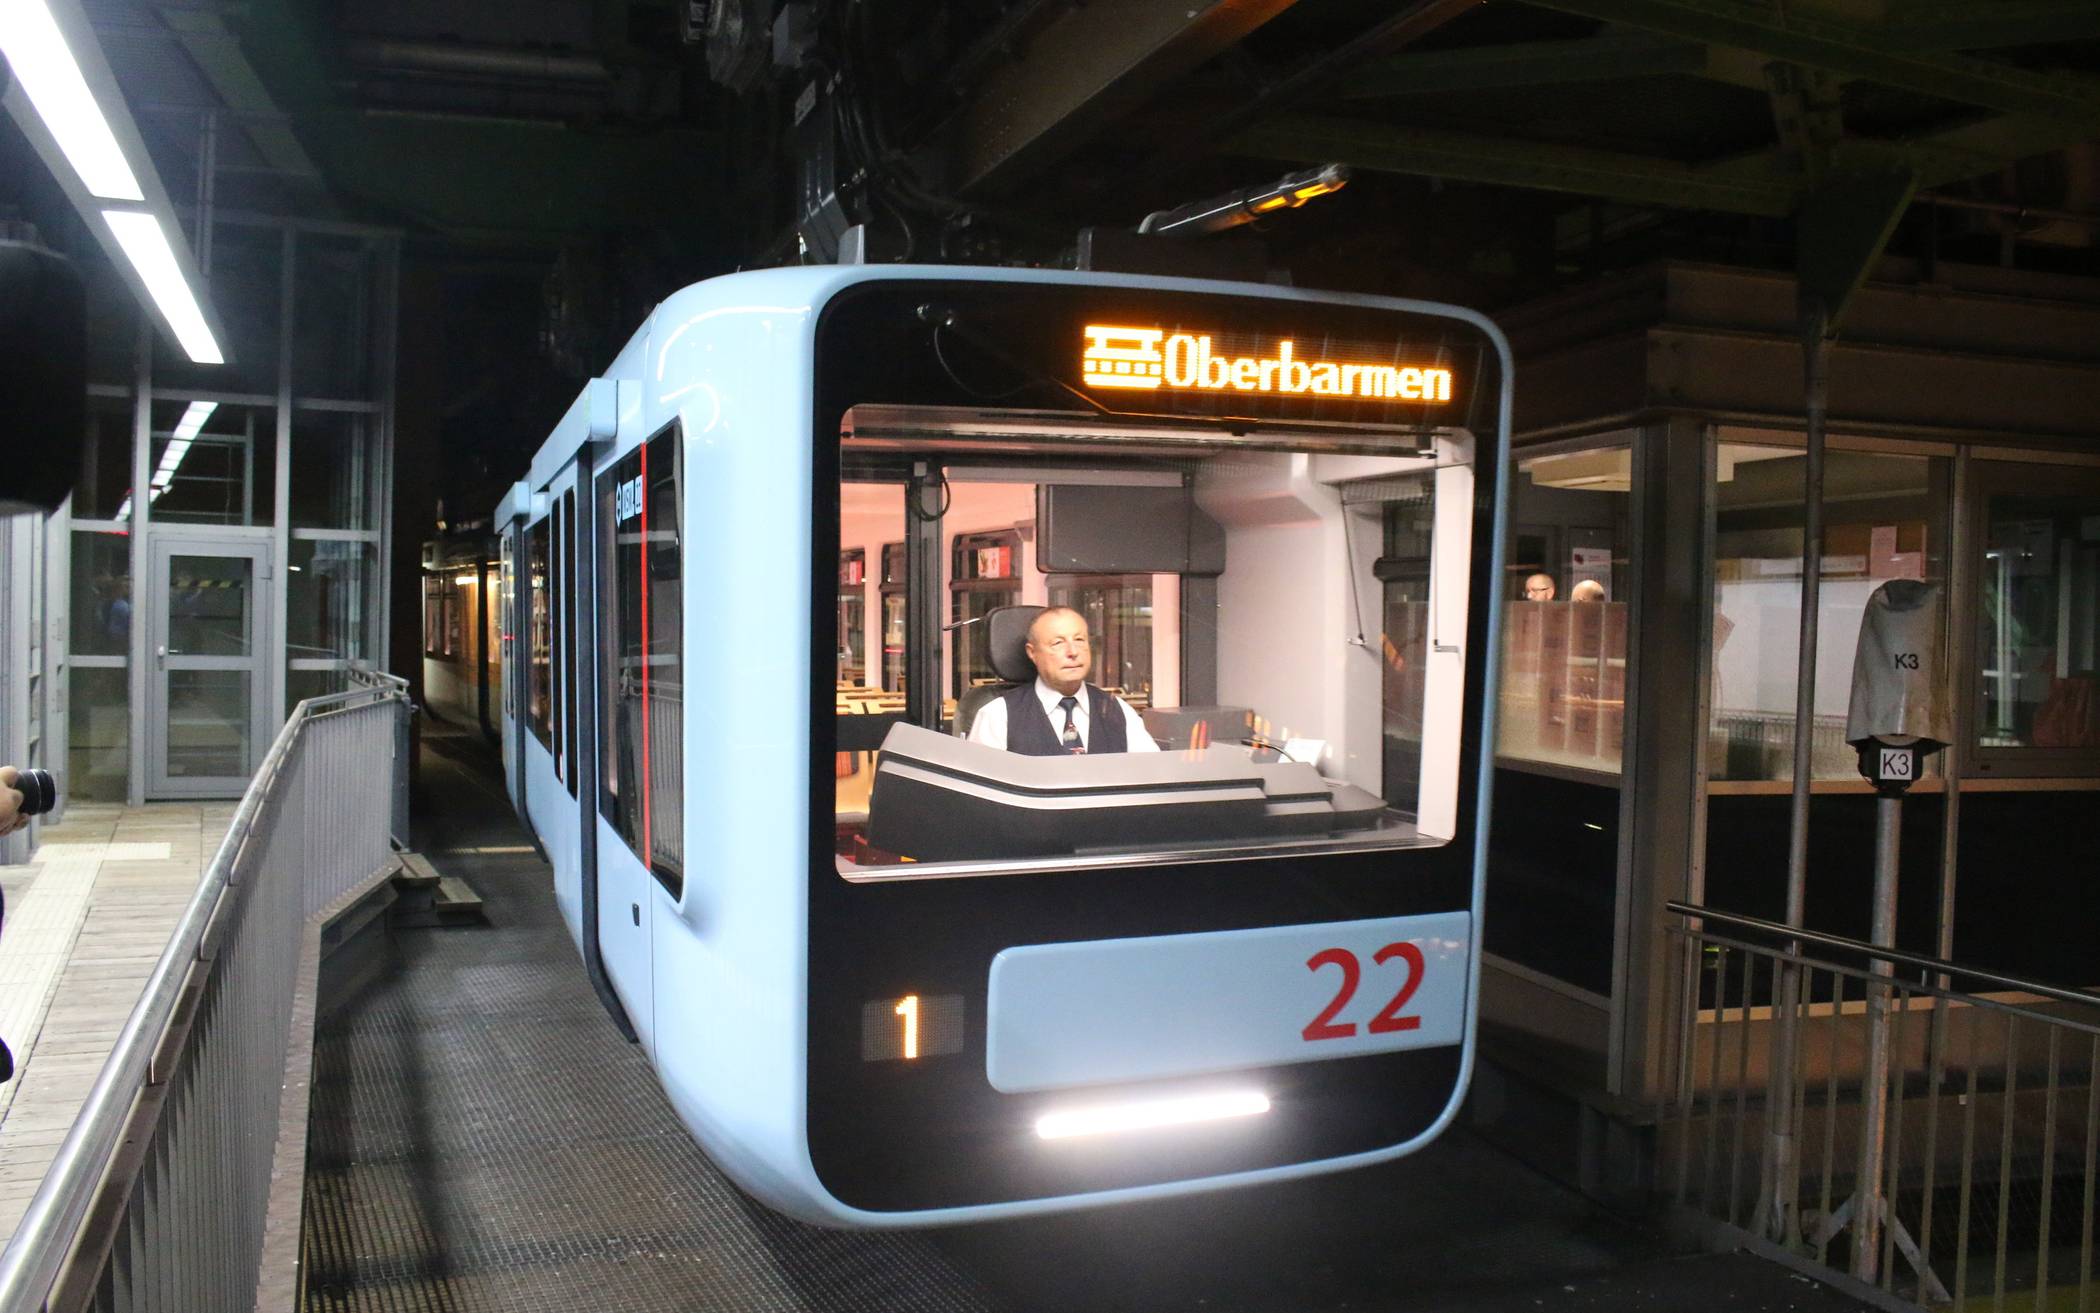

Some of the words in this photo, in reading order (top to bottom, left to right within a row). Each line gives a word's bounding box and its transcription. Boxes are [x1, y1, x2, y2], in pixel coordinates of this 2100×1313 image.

[1164, 333, 1452, 401] Oberbarmen
[1894, 653, 1919, 670] K3
[1882, 753, 1909, 776] K3
[1302, 942, 1424, 1041] 22
[895, 995, 918, 1059] 1
